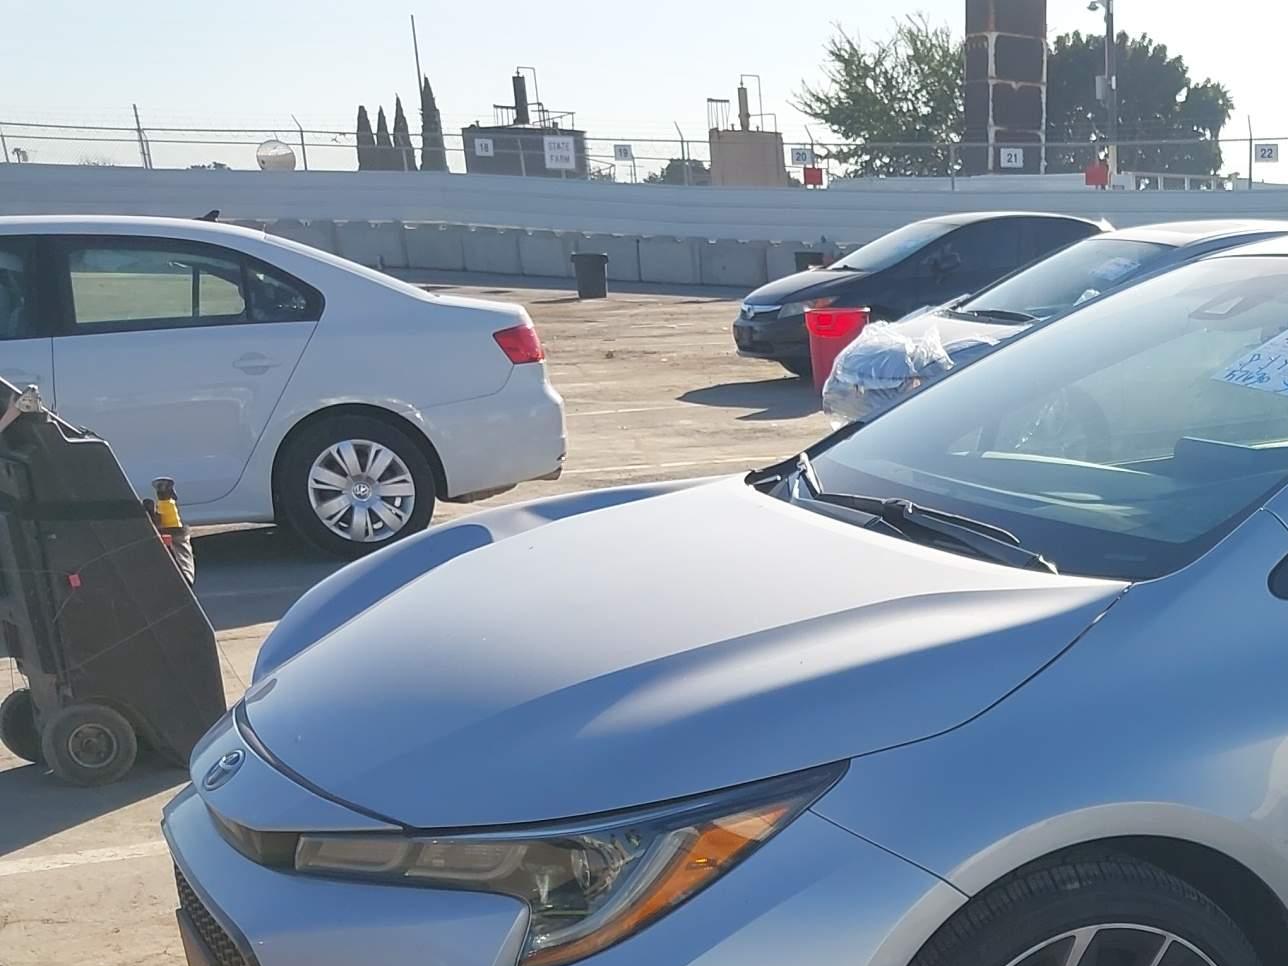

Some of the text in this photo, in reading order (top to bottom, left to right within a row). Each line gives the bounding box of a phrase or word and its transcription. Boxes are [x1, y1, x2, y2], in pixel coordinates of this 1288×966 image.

[618, 148, 629, 157] 19
[796, 152, 807, 161] 20
[1260, 147, 1273, 159] 22
[1007, 153, 1018, 163] 21
